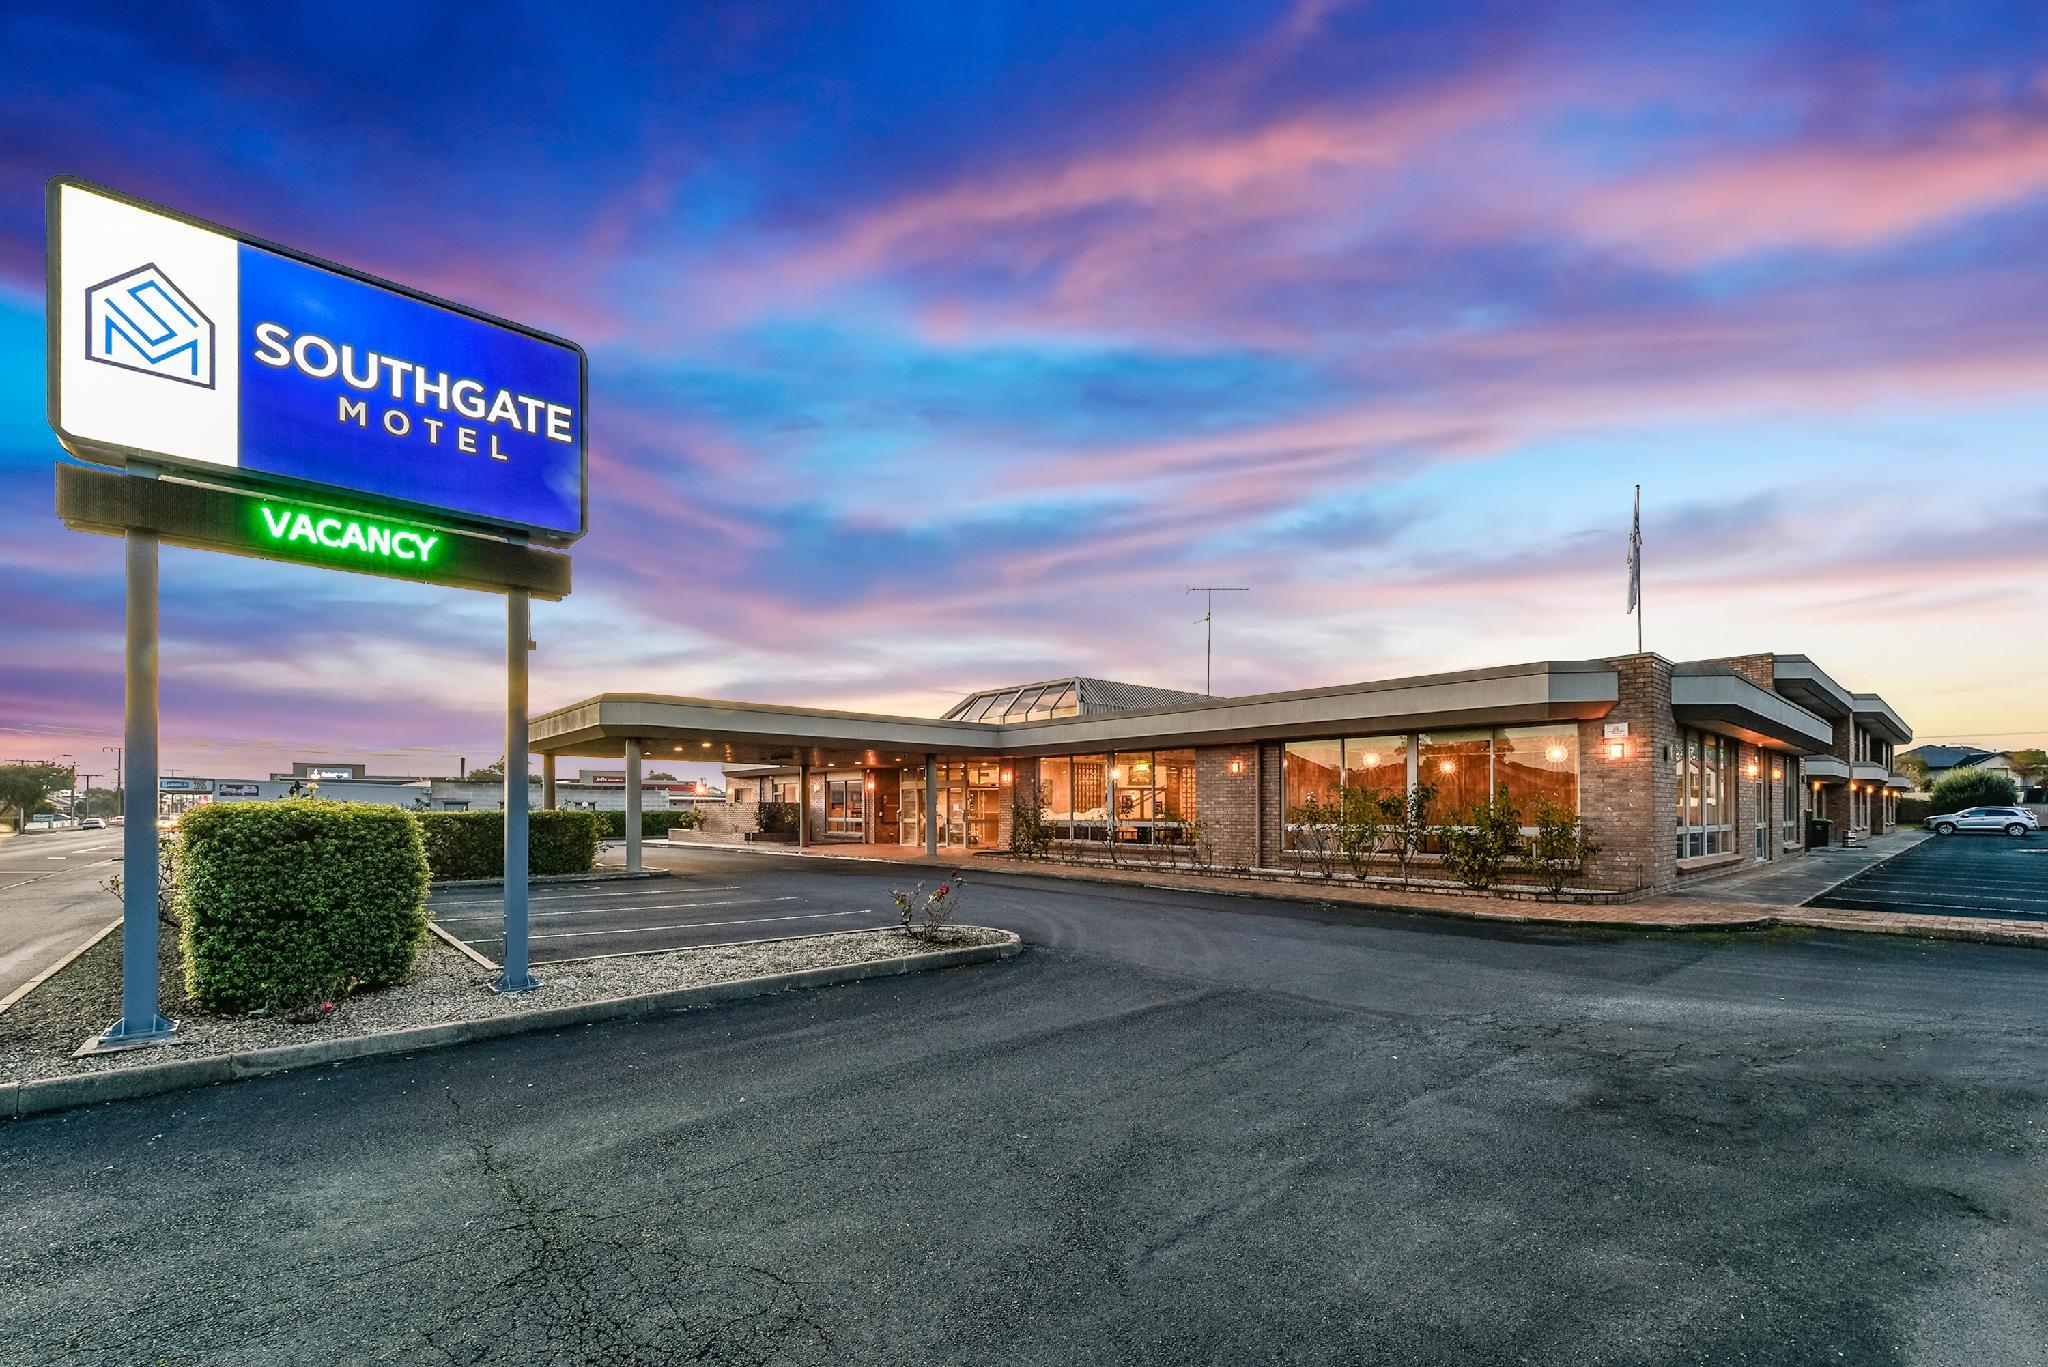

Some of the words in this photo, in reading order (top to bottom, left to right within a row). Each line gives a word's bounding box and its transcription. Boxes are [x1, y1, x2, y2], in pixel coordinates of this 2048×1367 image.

[254, 322, 573, 443] SOUTHGATE
[338, 396, 508, 461] MOTEL
[261, 507, 439, 562] VACANCY
